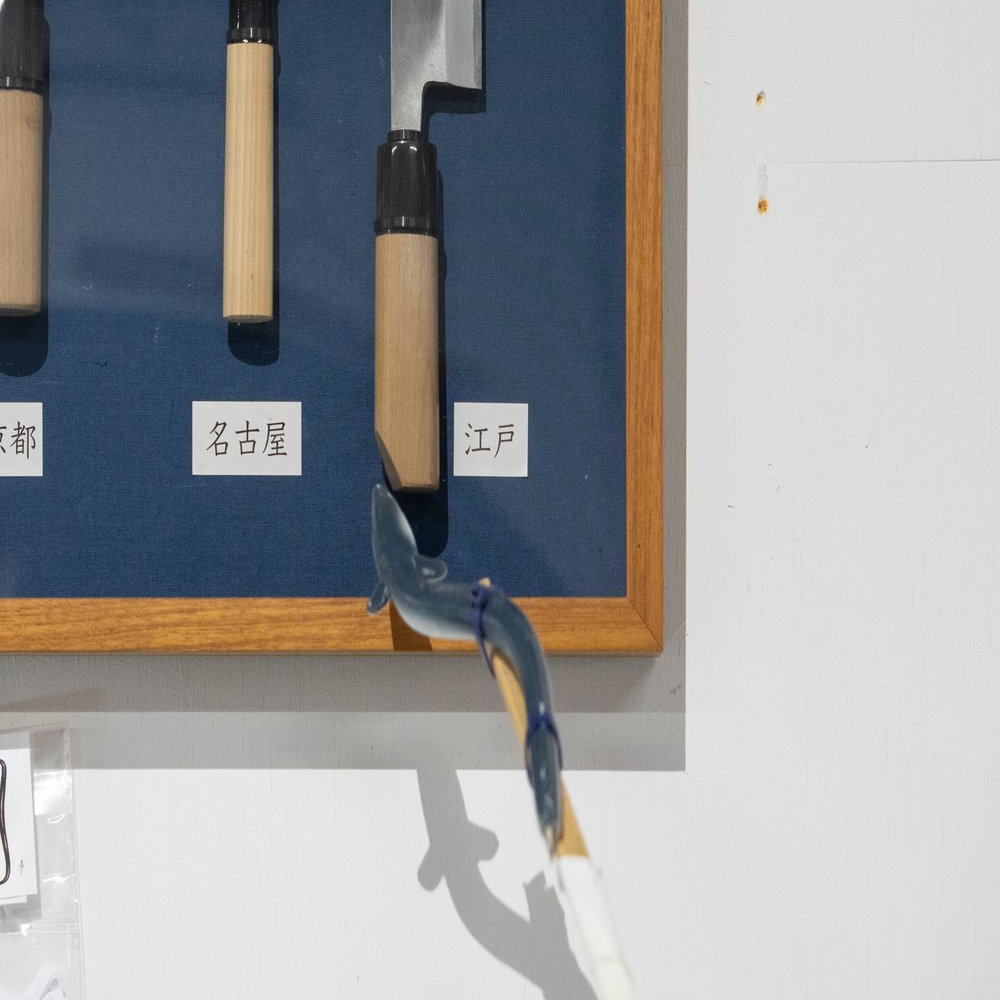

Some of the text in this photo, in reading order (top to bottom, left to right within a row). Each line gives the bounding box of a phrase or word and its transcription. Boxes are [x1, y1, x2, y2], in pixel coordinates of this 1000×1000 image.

[206, 420, 288, 457] 名古屋
[464, 422, 515, 458] 江戸
